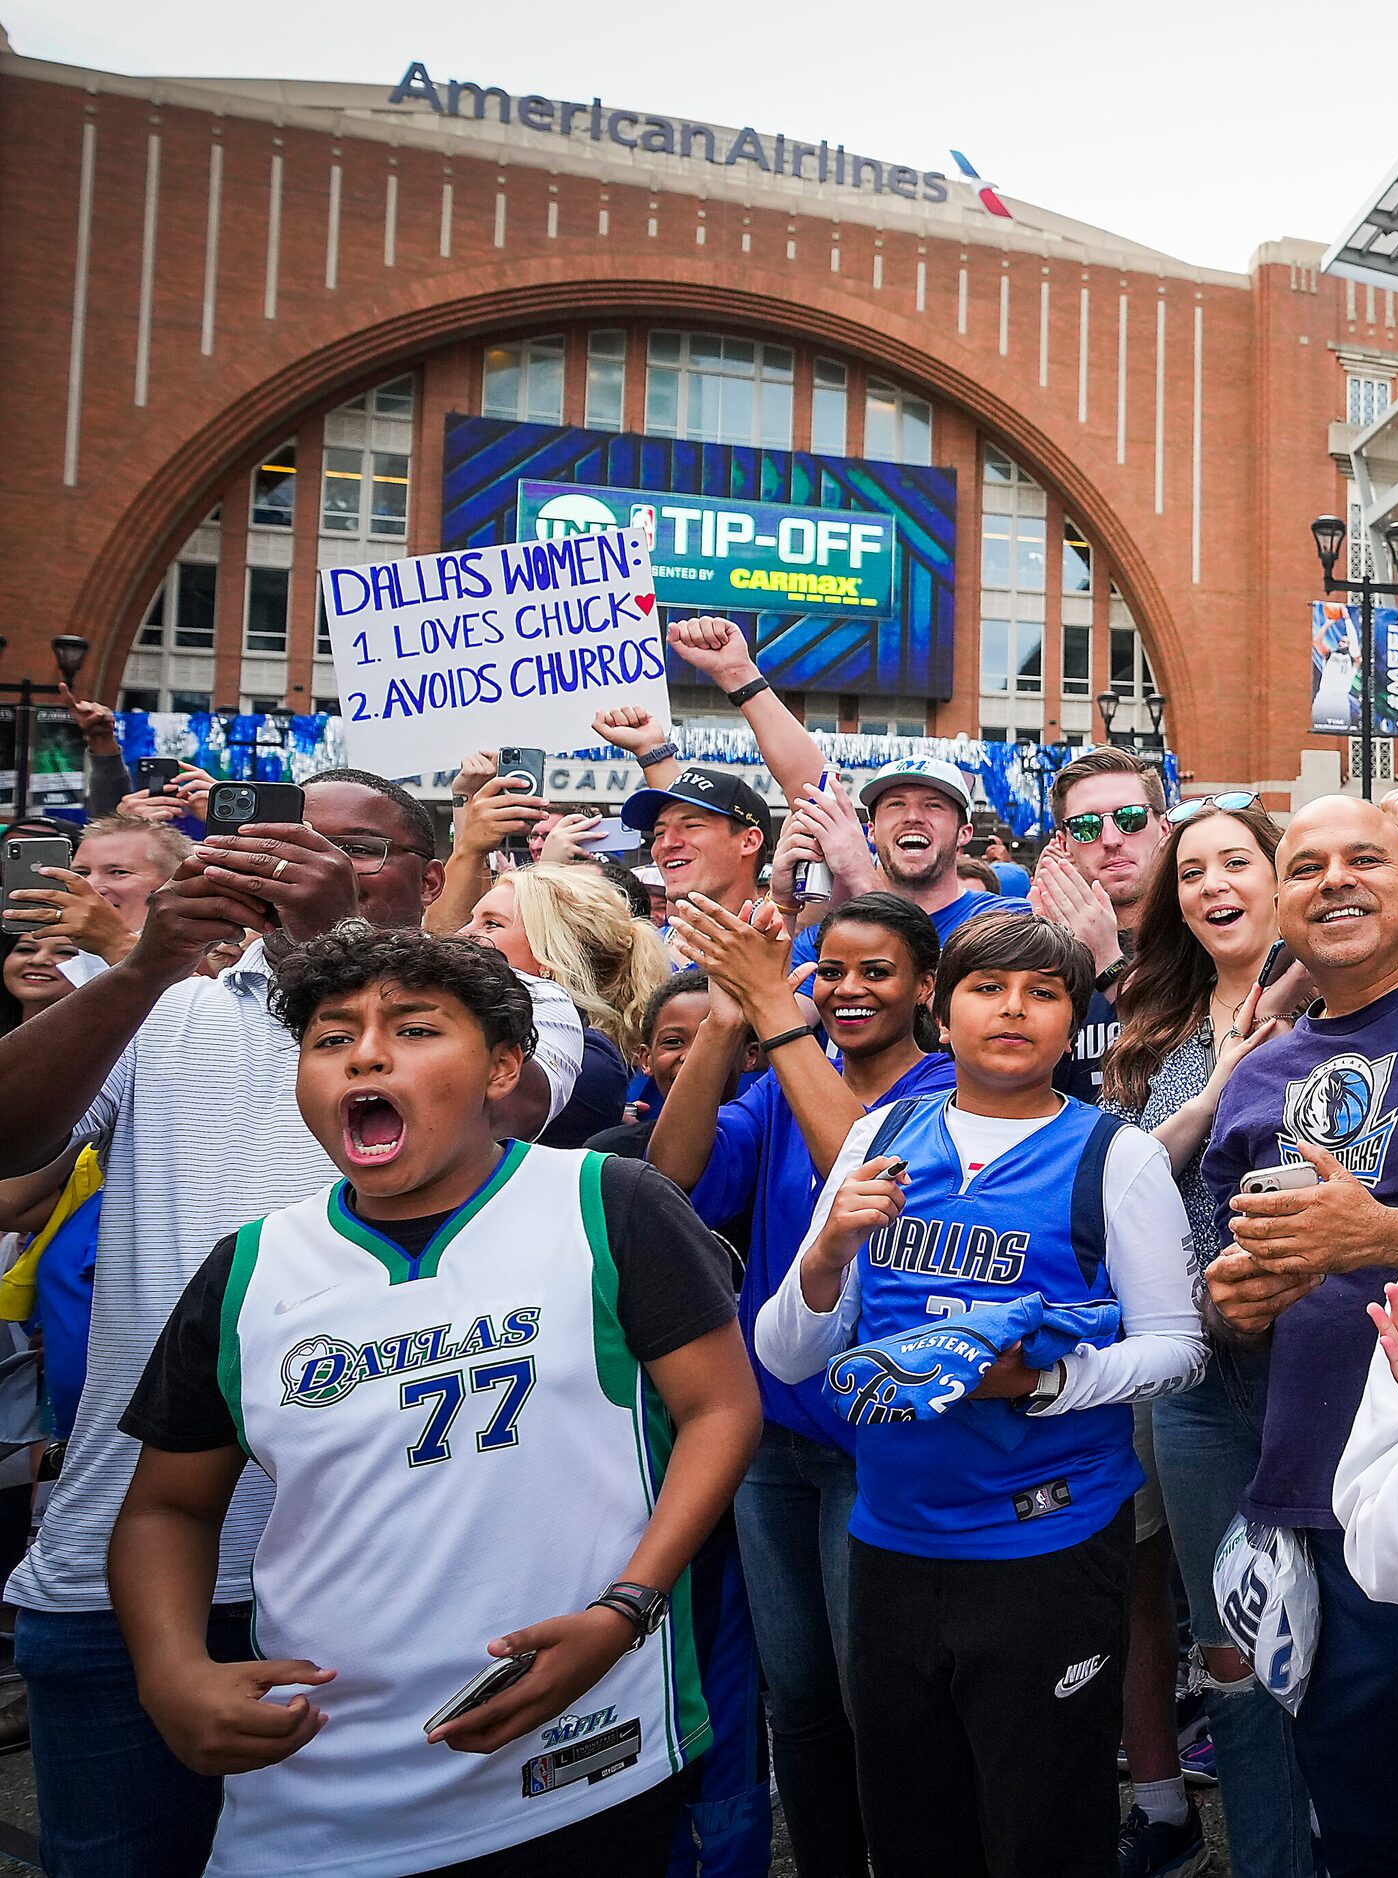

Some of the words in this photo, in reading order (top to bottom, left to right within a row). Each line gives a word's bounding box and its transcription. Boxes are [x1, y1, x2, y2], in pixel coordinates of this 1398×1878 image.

[389, 61, 716, 165] American
[725, 126, 948, 203] Airlines
[661, 505, 884, 569] TIP-OFF
[330, 552, 493, 617] DALLAS
[500, 532, 643, 596] WOMEN:
[651, 565, 697, 580] SENTED
[699, 568, 715, 581] BY
[352, 630, 382, 666] 1.
[393, 609, 505, 660] LOVES
[514, 591, 642, 640] CHUCK
[509, 636, 666, 698] CHURROS
[668, 772, 714, 792] DAL
[868, 1215, 1031, 1285] DALLAS
[284, 1306, 542, 1400] DALLAS
[900, 1335, 981, 1363] WESTERN
[400, 1355, 538, 1469] 77
[1063, 1654, 1101, 1685] NIKE
[541, 1704, 619, 1749] MFFL
